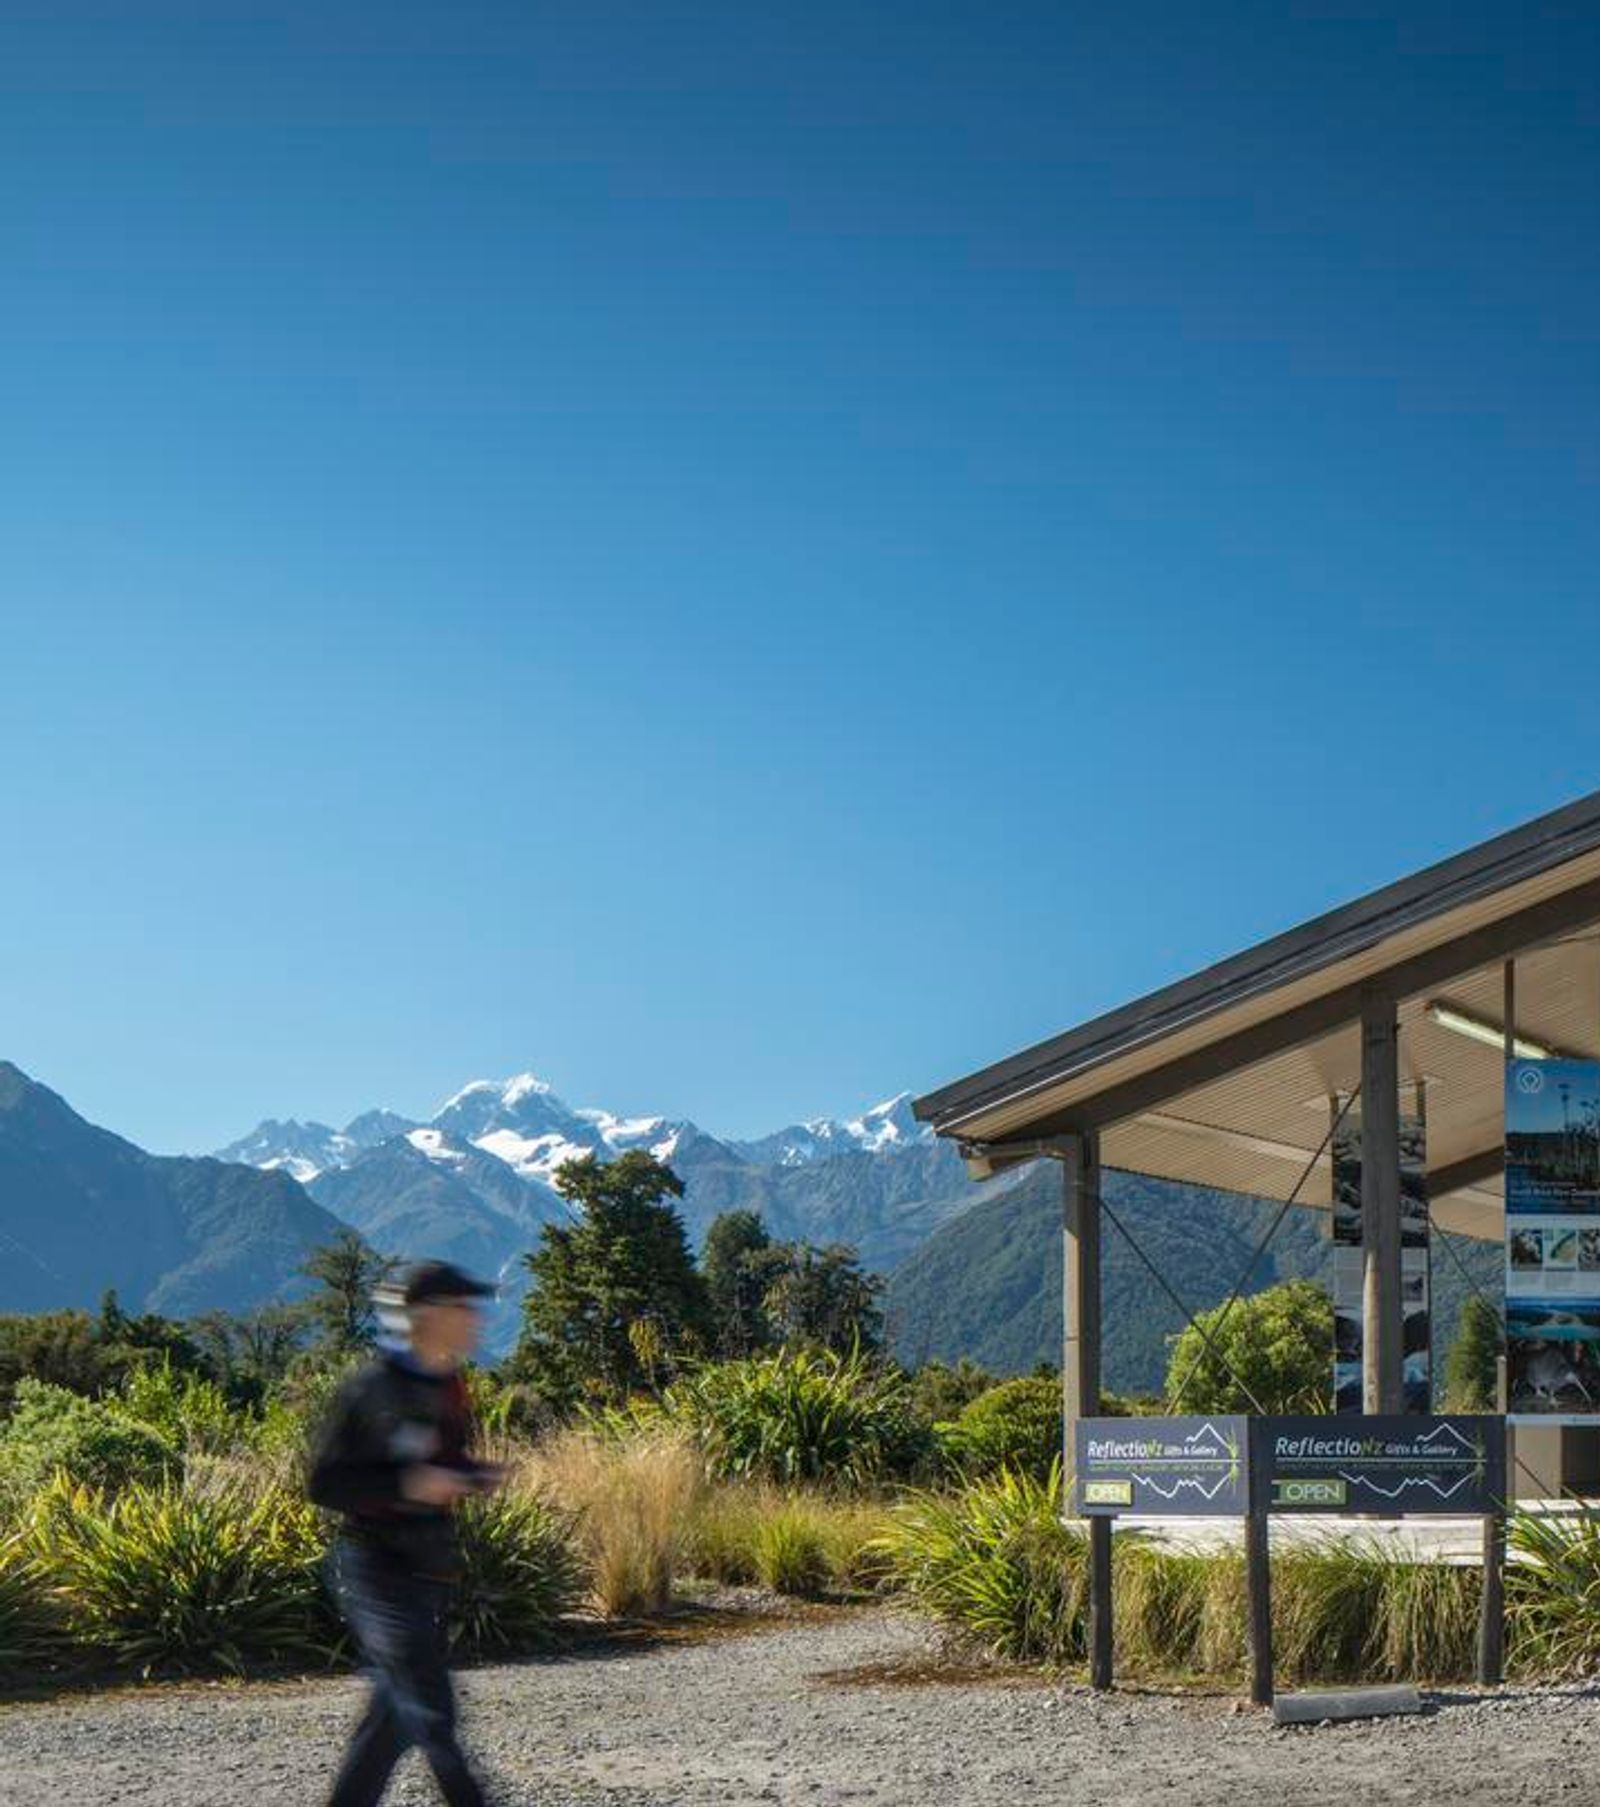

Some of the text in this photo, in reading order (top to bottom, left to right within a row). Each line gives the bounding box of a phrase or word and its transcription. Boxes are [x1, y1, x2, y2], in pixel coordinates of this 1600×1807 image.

[1183, 1445, 1190, 1456] &
[1191, 1445, 1217, 1457] Gallery
[1385, 1444, 1411, 1456] Gifts
[1413, 1445, 1421, 1455] &
[1422, 1444, 1458, 1457] Gallery
[1286, 1483, 1339, 1500] OPEN
